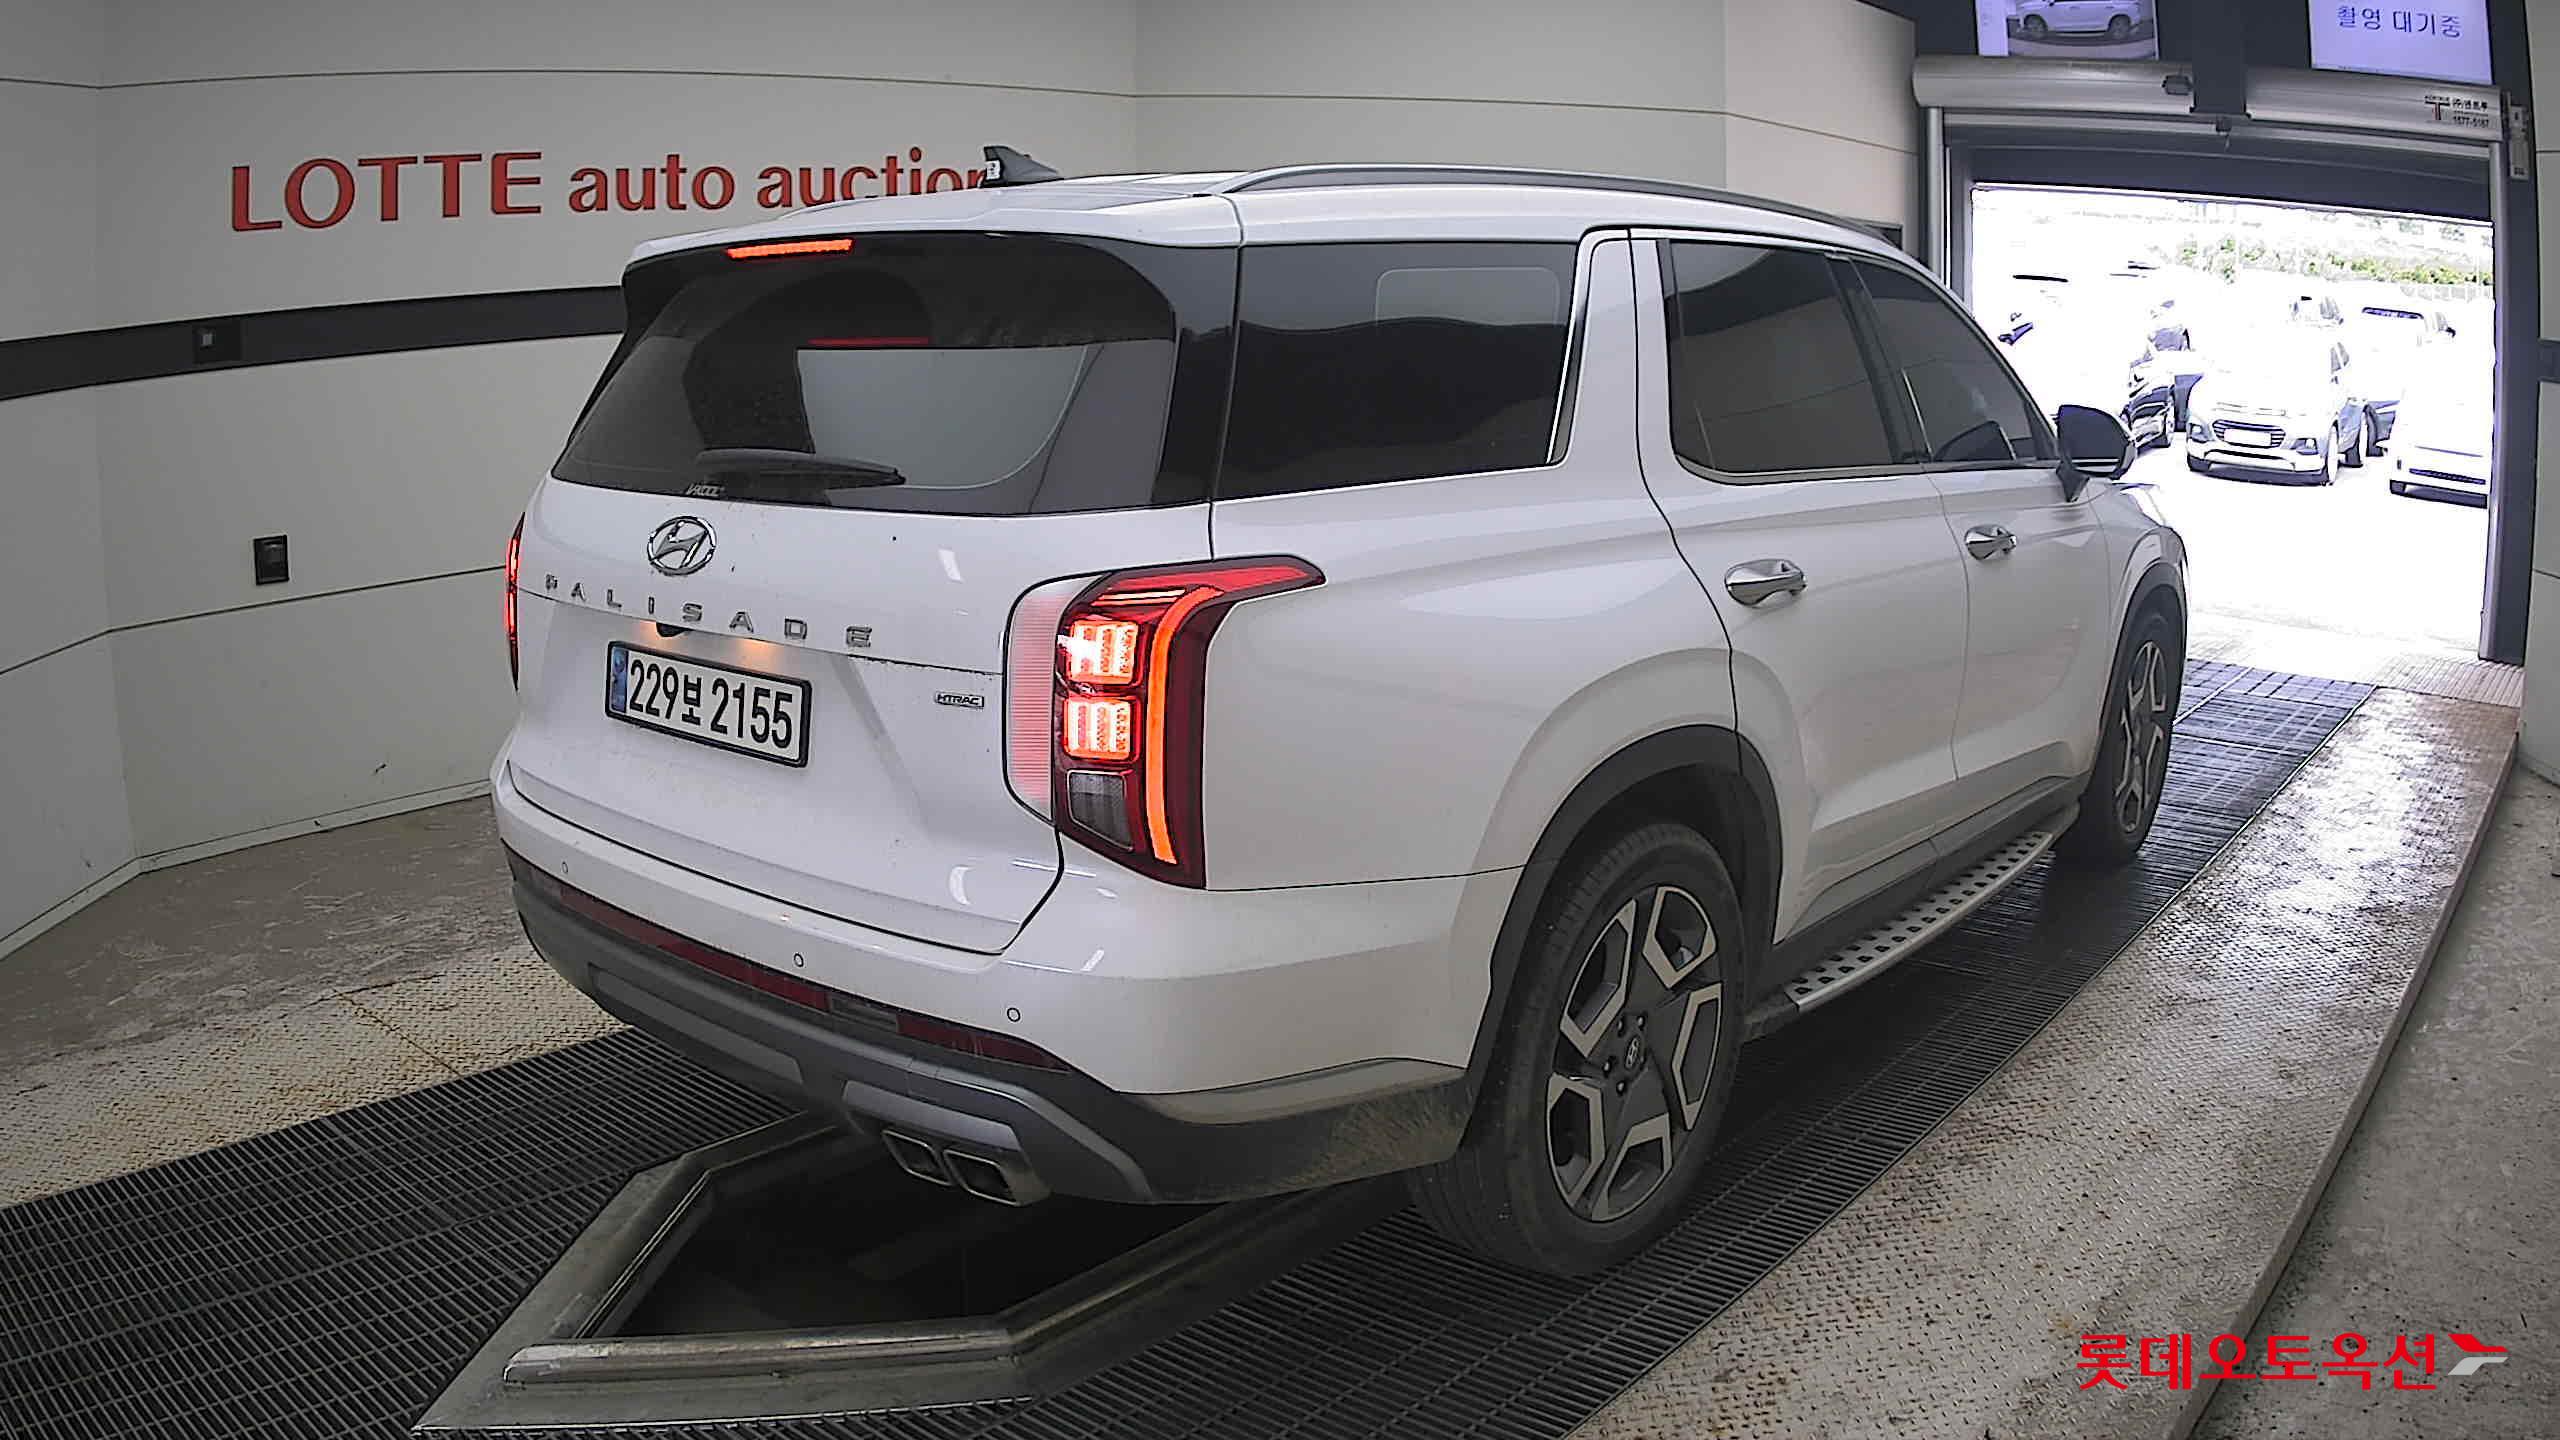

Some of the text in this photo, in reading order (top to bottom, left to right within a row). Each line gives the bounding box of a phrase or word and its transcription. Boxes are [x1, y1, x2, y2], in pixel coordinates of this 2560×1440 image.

[2338, 6, 2460, 38] 촬영 대기중
[232, 152, 542, 231] LOTTE
[568, 154, 736, 212] auto
[545, 573, 873, 648] PALISADE
[630, 659, 793, 749] 229보 2155
[936, 693, 982, 706] HTRAC
